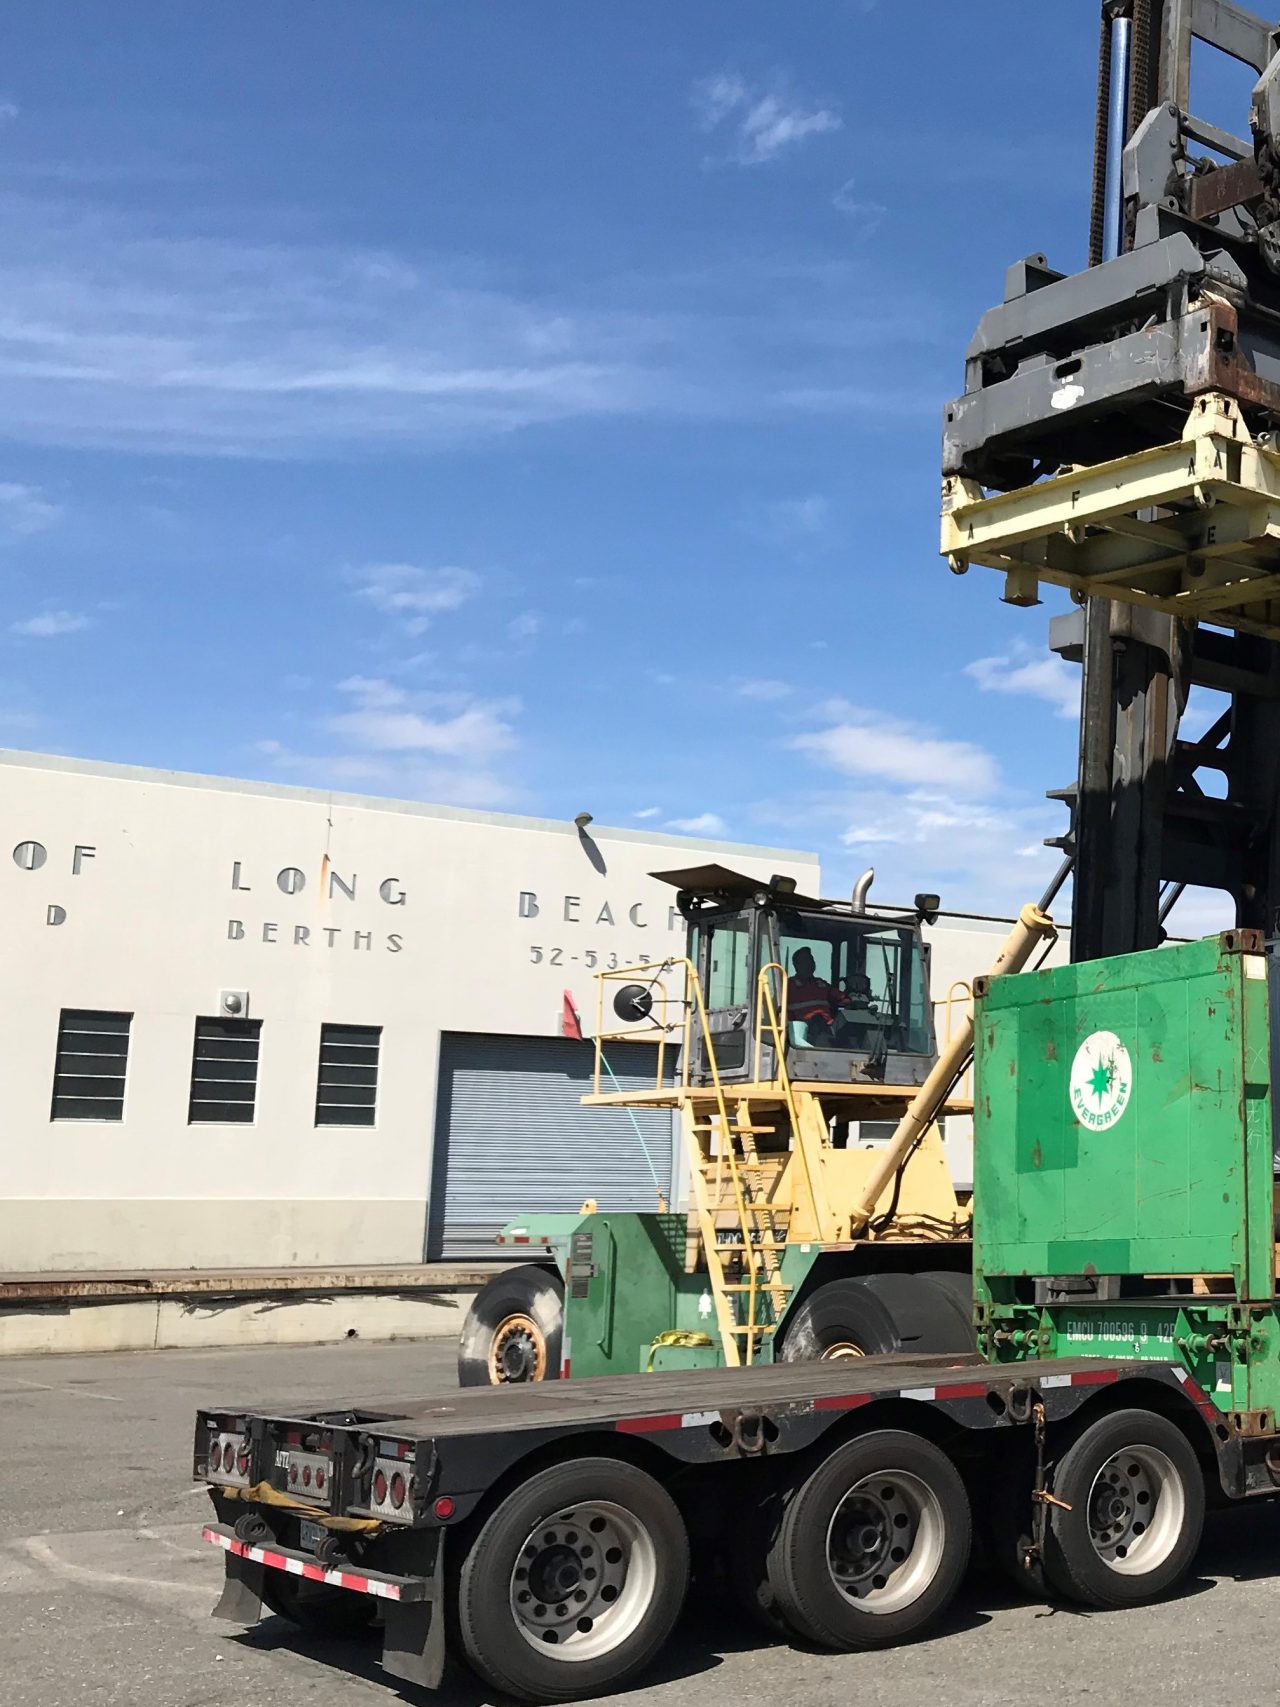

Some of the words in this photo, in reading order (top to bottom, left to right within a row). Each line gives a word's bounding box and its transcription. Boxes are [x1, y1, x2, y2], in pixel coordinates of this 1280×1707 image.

[1213, 449, 1222, 470] A
[1071, 489, 1080, 510] F
[967, 522, 975, 541] A
[1206, 525, 1216, 545] E
[13, 840, 96, 875] OF
[232, 861, 406, 906] LONG
[519, 891, 688, 932] BEACH
[46, 904, 67, 926] D
[228, 920, 404, 953] BERTHS
[1074, 1082, 1128, 1126] EVERGREEN
[1066, 1321, 1094, 1341] EMCU
[1098, 1321, 1134, 1342] 700596
